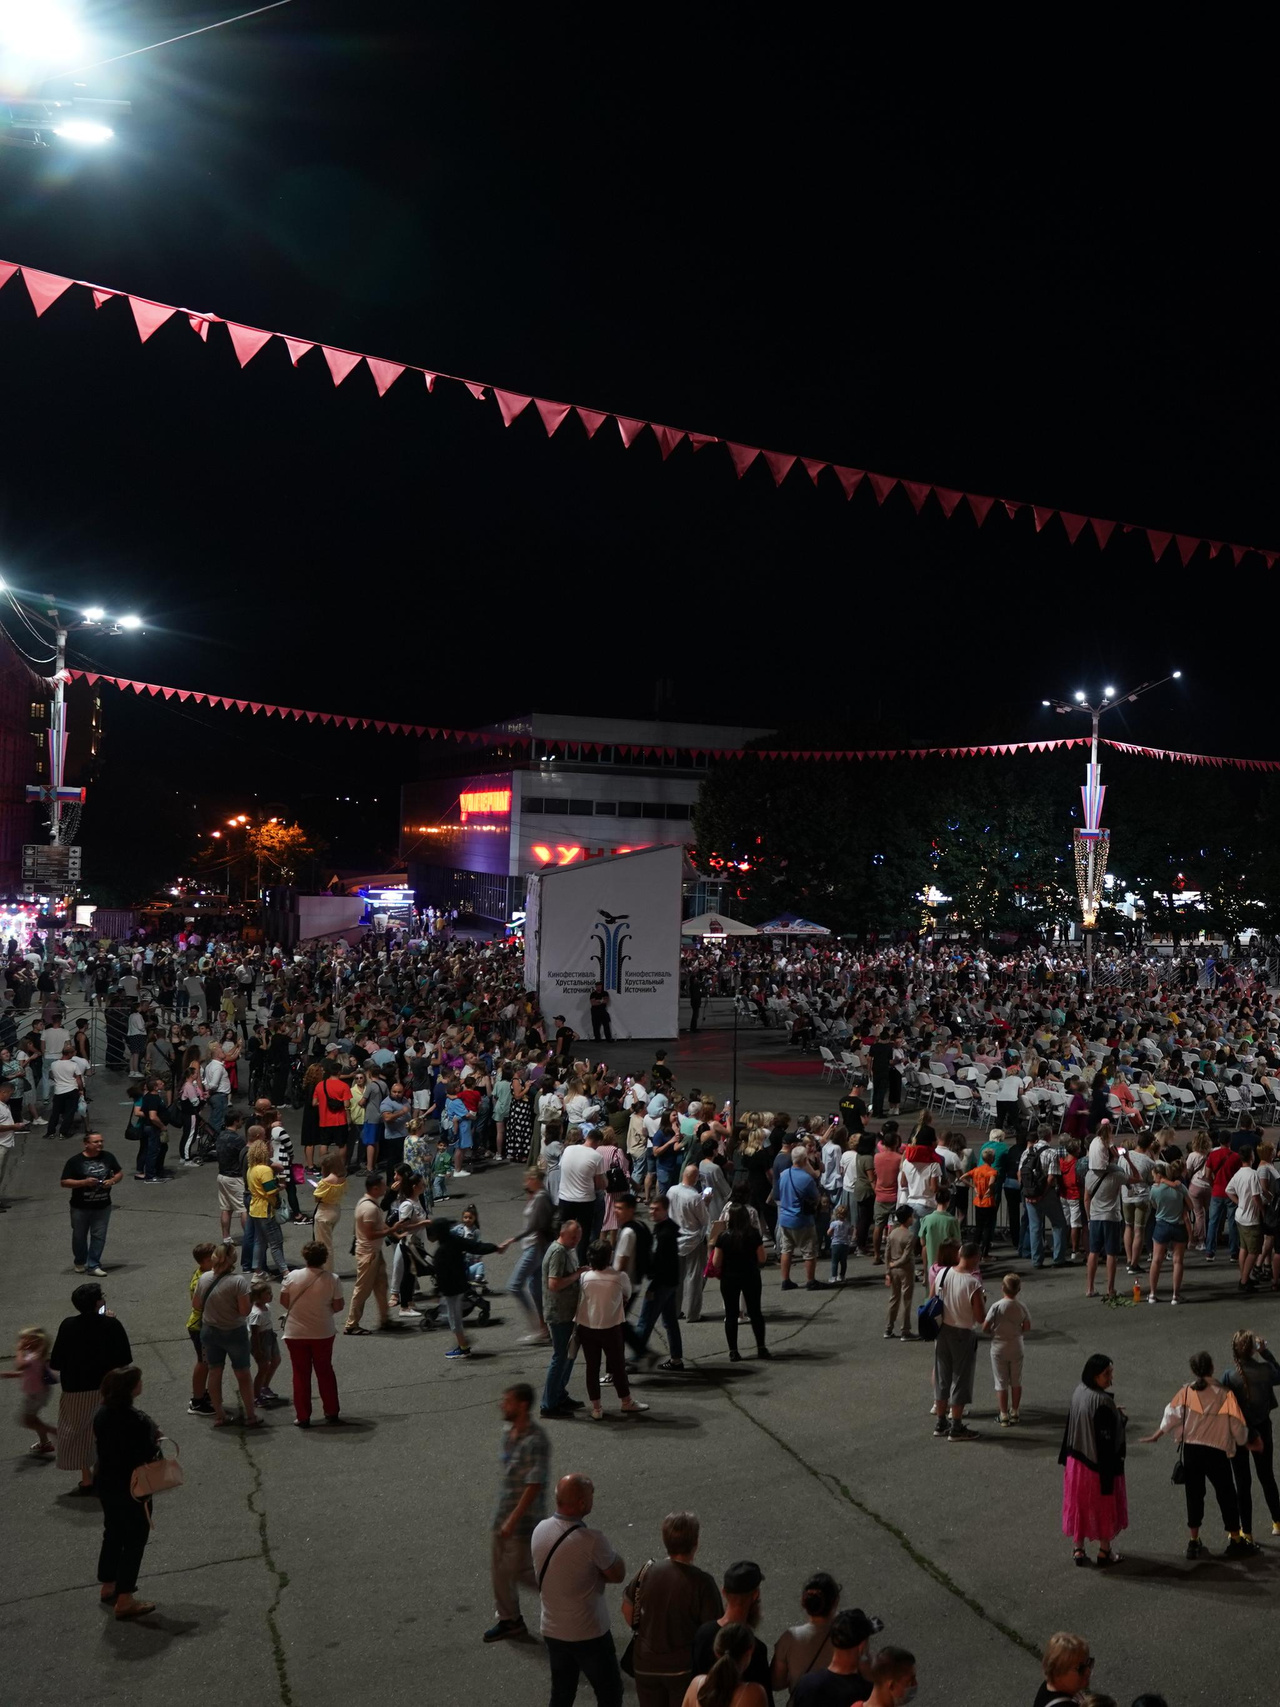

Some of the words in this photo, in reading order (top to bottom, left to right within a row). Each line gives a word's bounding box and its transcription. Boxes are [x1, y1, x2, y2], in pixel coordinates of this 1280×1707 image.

[547, 970, 596, 978] Кинофестиваль
[624, 970, 672, 978] Кинофестиваль
[624, 978, 664, 987] Хрустальный
[624, 986, 657, 994] ИсточникЪ
